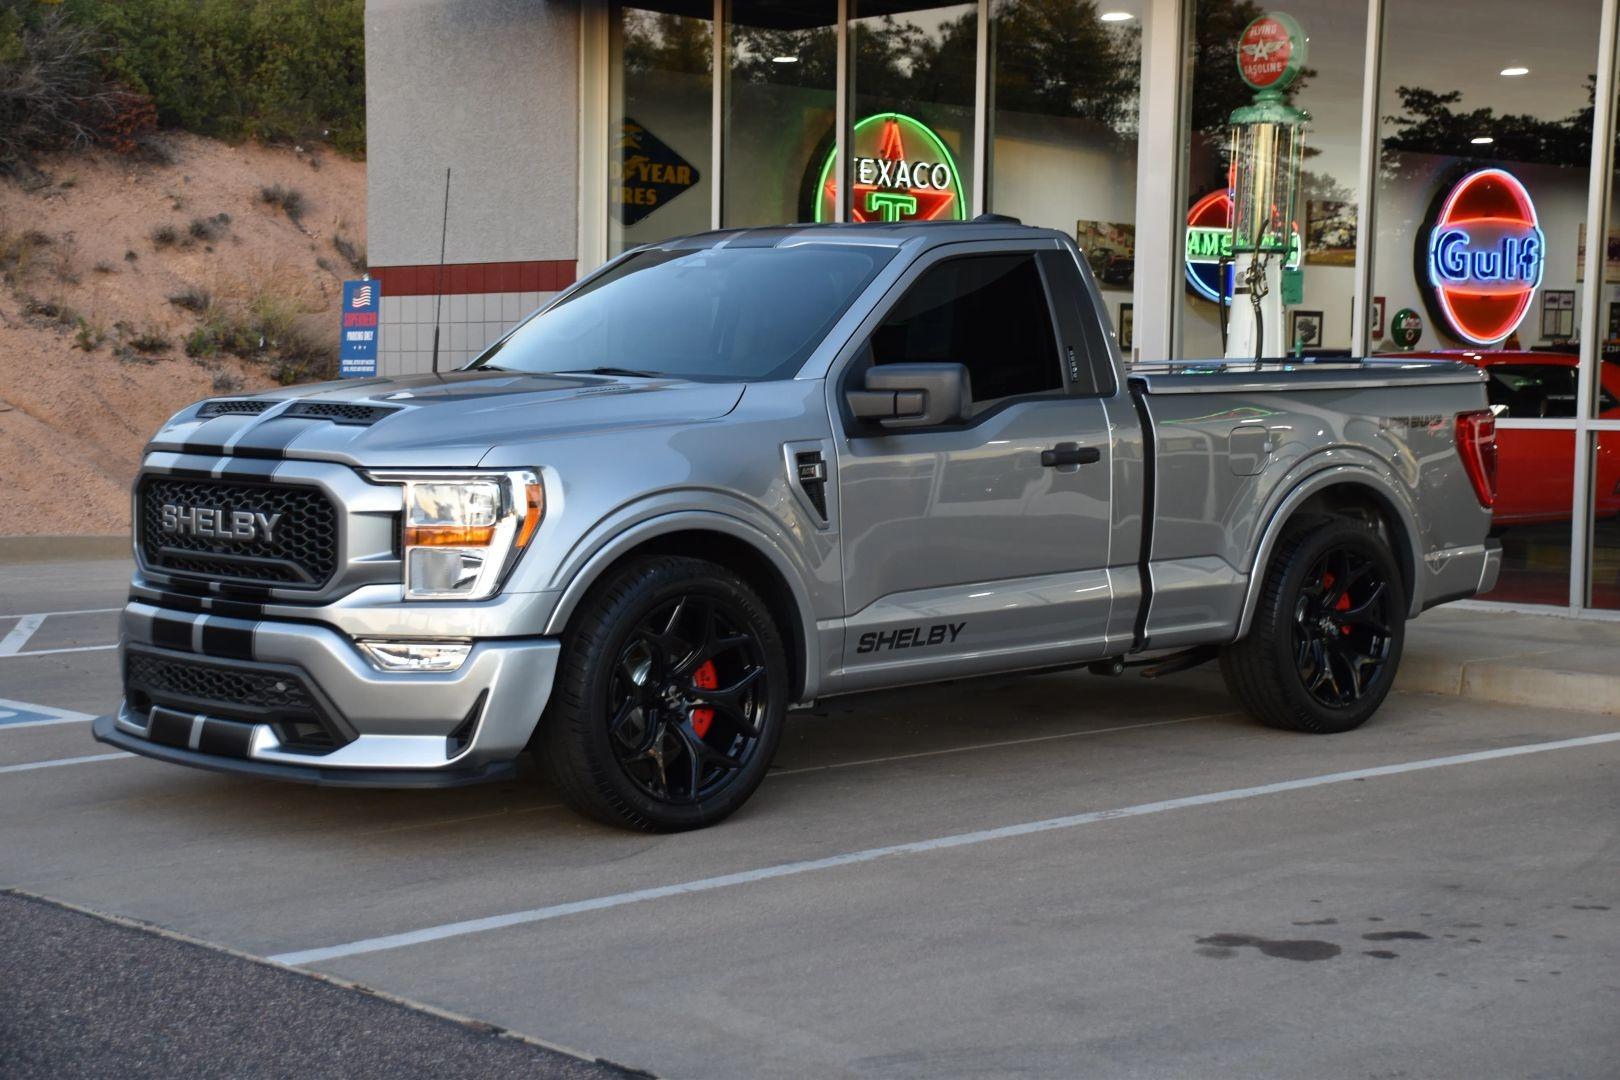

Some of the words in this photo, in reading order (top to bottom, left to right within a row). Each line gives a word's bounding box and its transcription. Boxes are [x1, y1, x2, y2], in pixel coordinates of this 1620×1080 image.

[1244, 62, 1282, 75] GASOLINE
[853, 157, 951, 190] EXACO
[1434, 230, 1540, 280] Gulf
[161, 504, 281, 542] SHELBY
[856, 621, 967, 654] SHELBY
